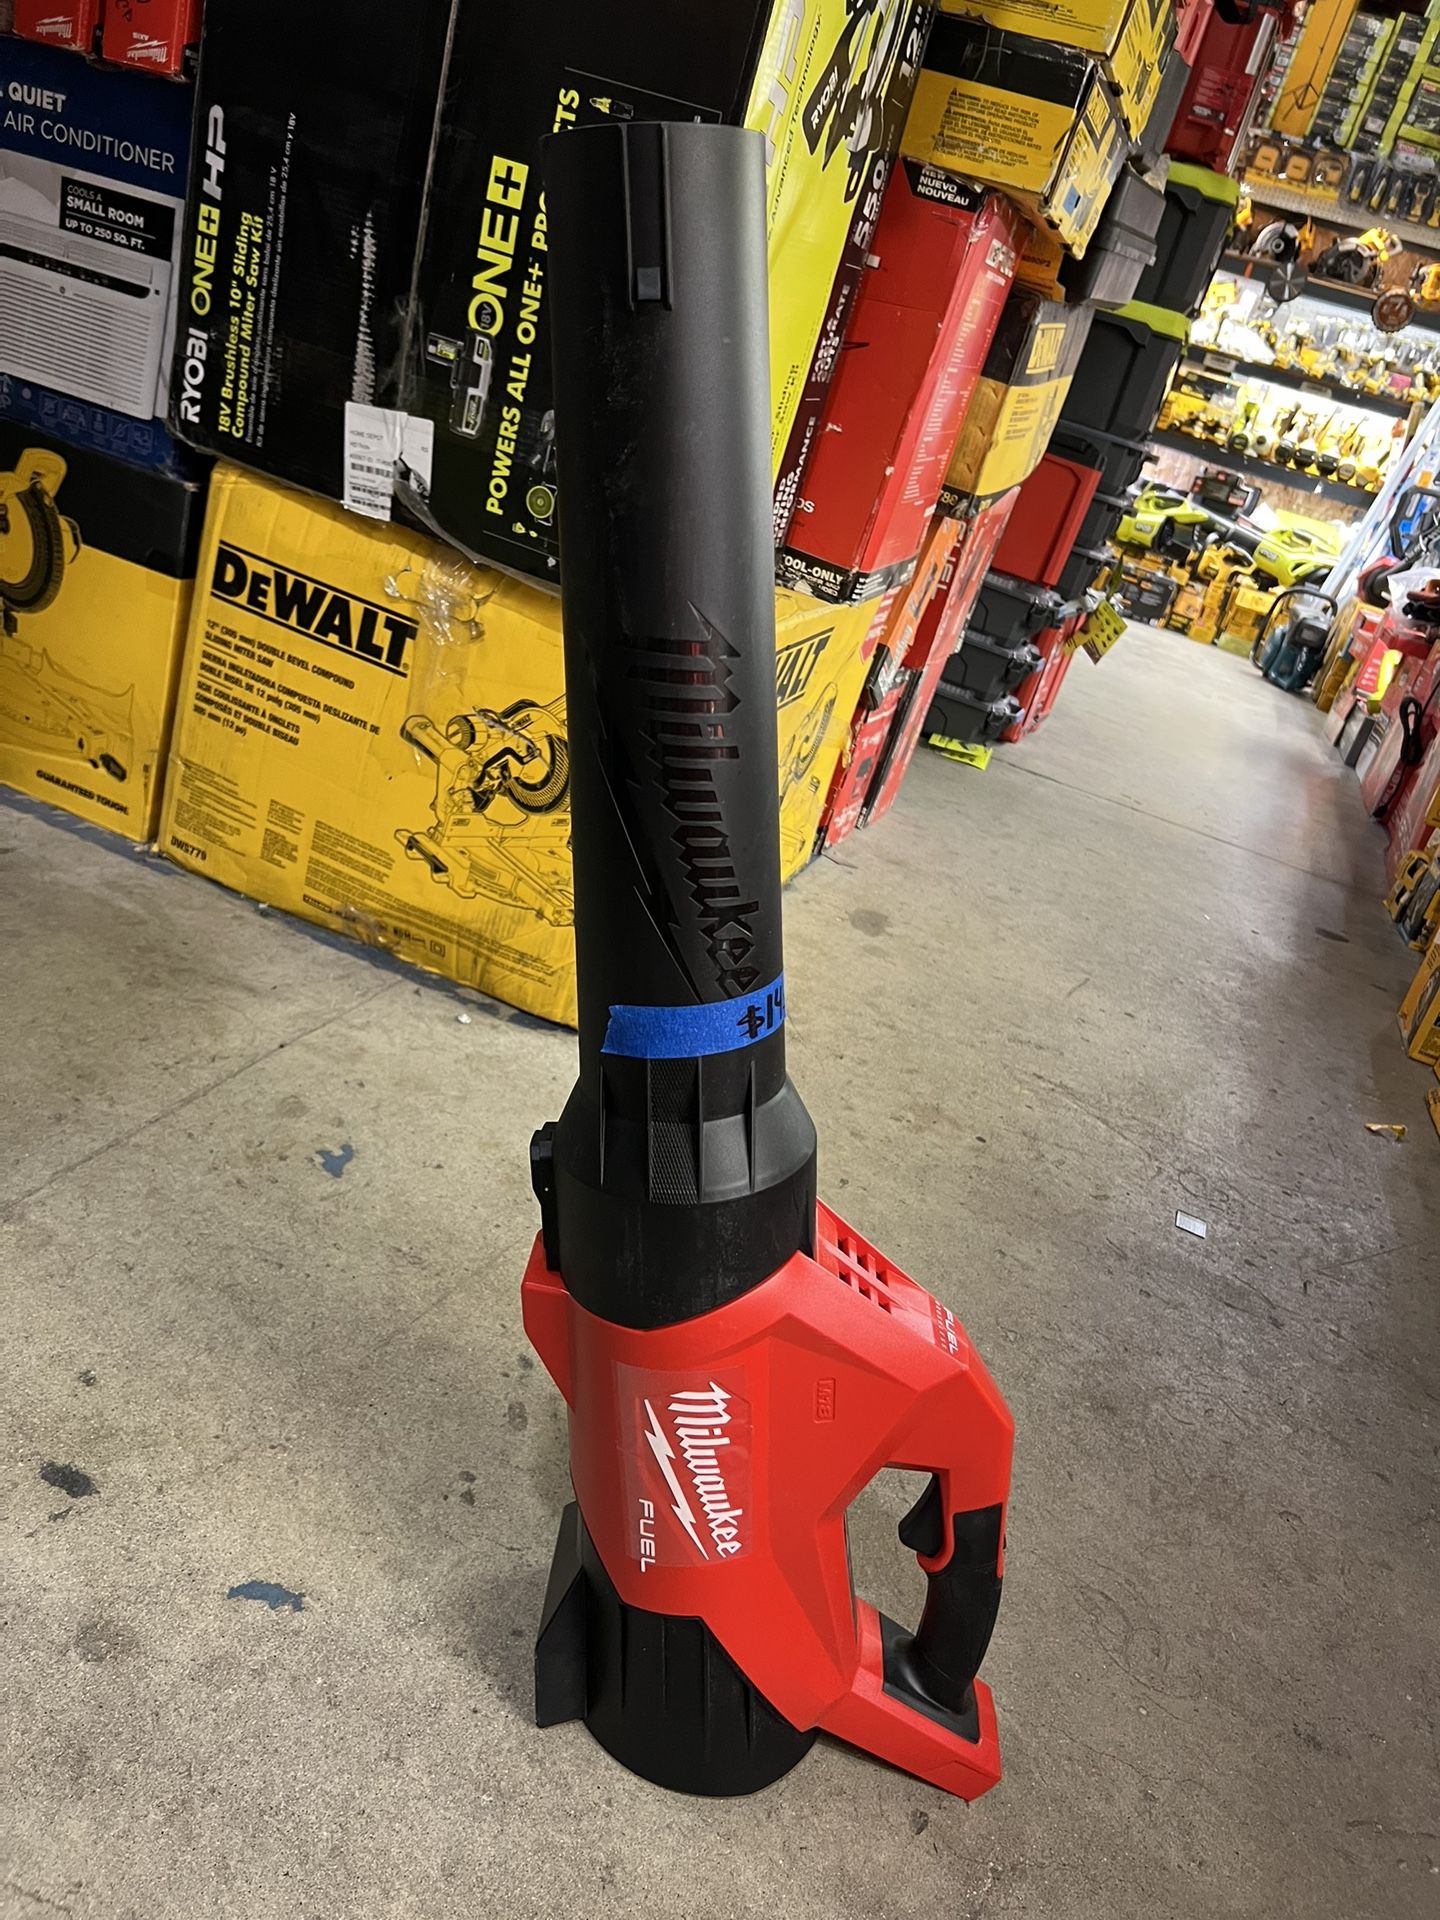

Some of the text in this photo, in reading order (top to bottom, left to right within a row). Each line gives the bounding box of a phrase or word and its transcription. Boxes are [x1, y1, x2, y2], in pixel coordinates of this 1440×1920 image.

[8, 81, 67, 113] QUIET
[286, 112, 296, 131] 18V
[811, 65, 838, 130] RYOBI
[4, 110, 175, 174] AIR CONDITIONER
[284, 140, 291, 156] cm
[772, 132, 794, 223] Advanced
[917, 184, 969, 206] NOUVEAU
[920, 176, 957, 194] NUEVO
[66, 195, 144, 228] SMALL ROOM
[853, 159, 885, 249] 550
[65, 219, 146, 250] UP TO 250 SQ. FT.
[468, 155, 529, 337] ONE+
[180, 104, 226, 424] RYOBI ONE+ HP
[218, 211, 252, 432] 18V Brushless 10" Sliding
[231, 215, 264, 438] Compound Miter Saw Kit
[480, 303, 491, 329] 18V
[486, 263, 544, 515] POWERS ALL ONE+
[783, 554, 843, 584] OOL-ONLY
[211, 546, 419, 669] DEWALT
[254, 687, 266, 698] 12
[309, 663, 356, 690] COMPOUND
[275, 683, 322, 709] COMPUESTA
[321, 702, 369, 730] DESLIZANTE
[367, 722, 382, 735] DE
[34, 768, 96, 800] GUARANTEED
[615, 600, 759, 998] Milwaukee
[943, 1306, 958, 1354] FUEL
[668, 1381, 743, 1558] Milwaukee
[638, 1498, 656, 1572] FUEL
